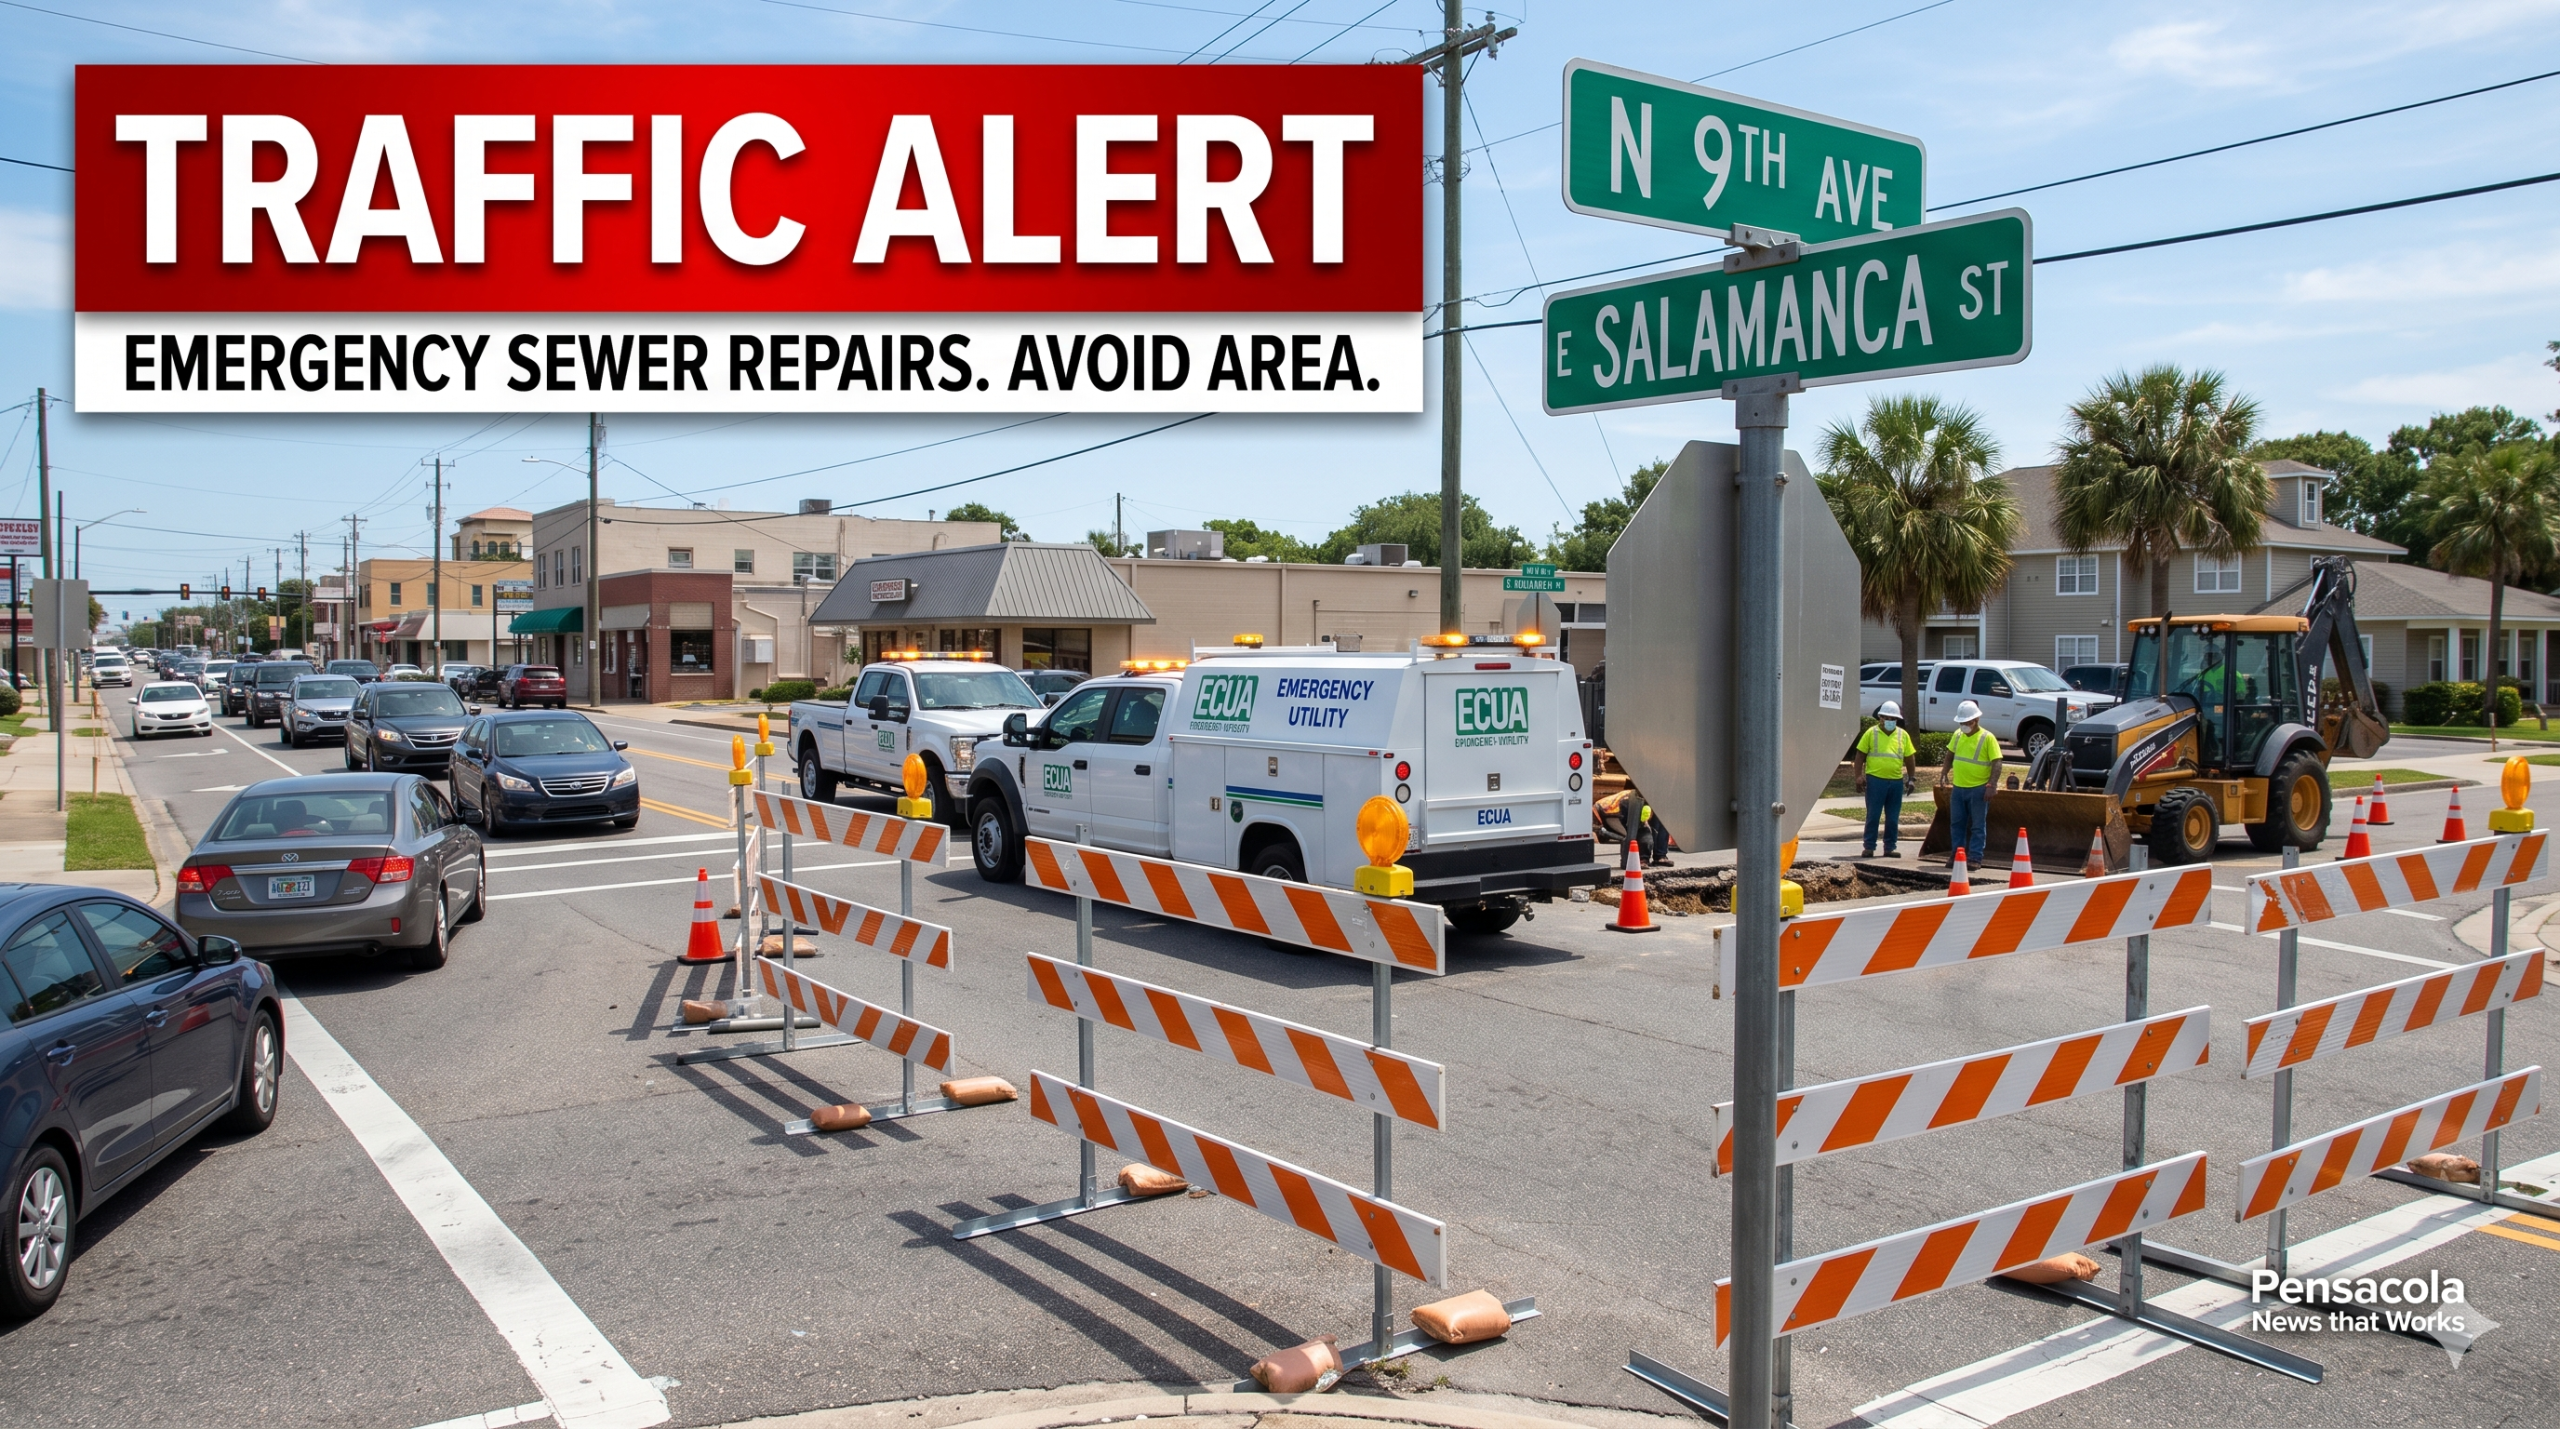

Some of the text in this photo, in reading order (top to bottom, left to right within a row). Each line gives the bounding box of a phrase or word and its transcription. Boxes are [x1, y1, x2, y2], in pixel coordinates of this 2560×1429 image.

[1610, 95, 1894, 231] N 9TH AVE
[1557, 253, 2009, 389] E SALAMANCA ST
[1195, 678, 1254, 719] ECUA
[1276, 678, 1375, 701] EMERGENCY
[1288, 705, 1350, 729] UTILITY
[1457, 690, 1528, 731] ECUA
[1044, 766, 1071, 792] ECUA
[1477, 808, 1512, 826] ECUA
